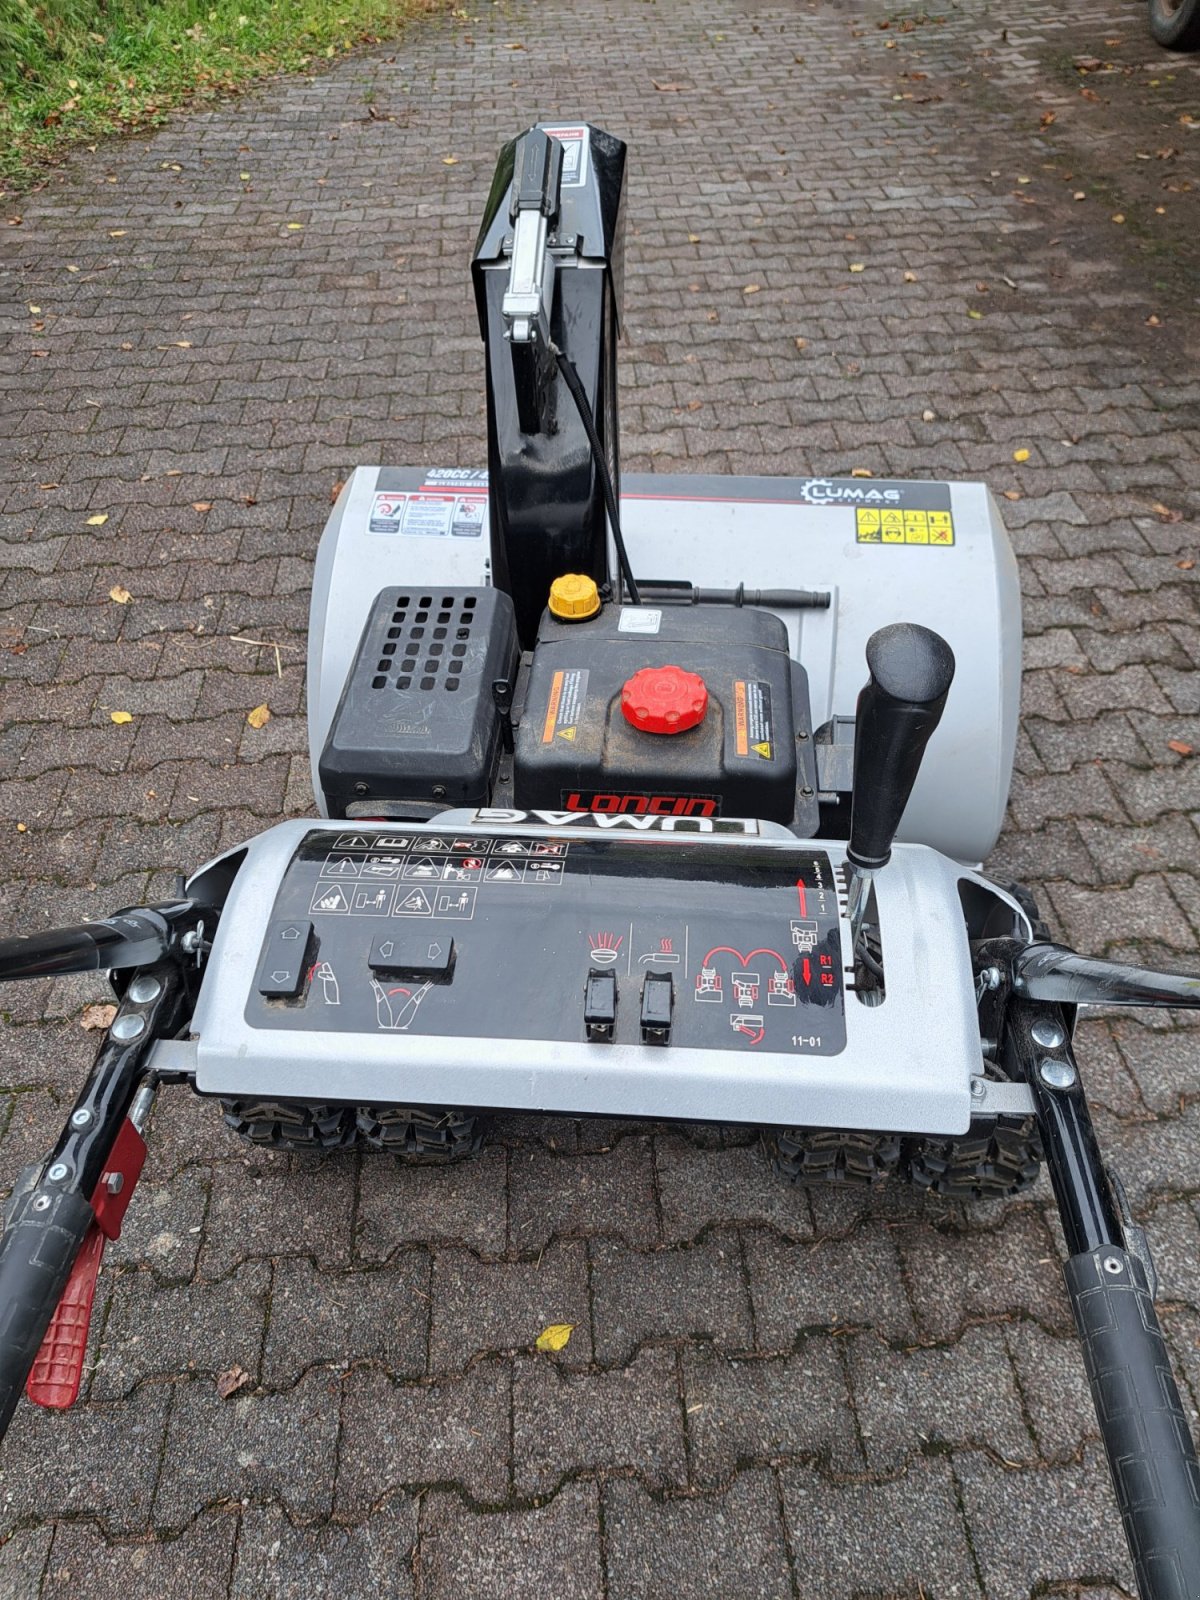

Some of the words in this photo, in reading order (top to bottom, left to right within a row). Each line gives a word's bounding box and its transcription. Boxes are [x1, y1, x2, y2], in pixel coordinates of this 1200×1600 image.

[426, 468, 471, 479] 420CC
[472, 807, 758, 834] LUMAG
[817, 881, 823, 889] 3
[818, 891, 825, 900] 2
[820, 955, 832, 965] R1
[820, 973, 833, 984] R2
[791, 1036, 822, 1047] 11-01
